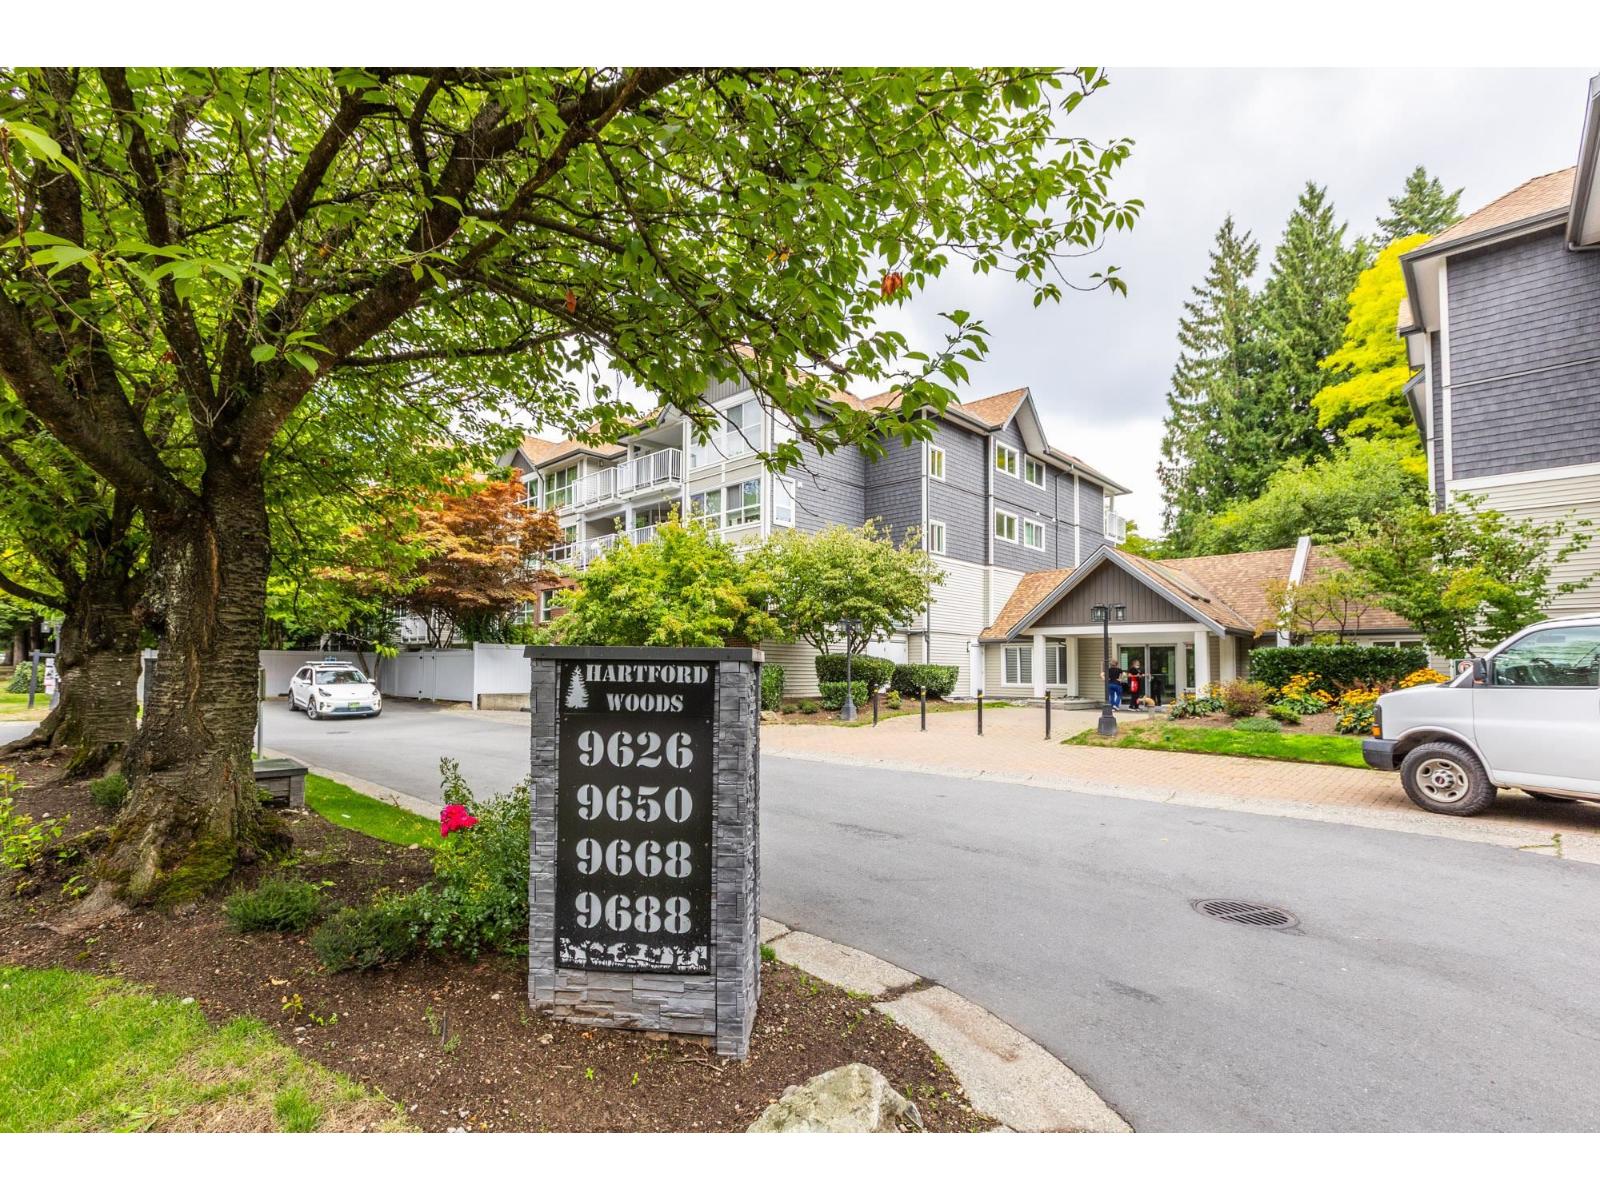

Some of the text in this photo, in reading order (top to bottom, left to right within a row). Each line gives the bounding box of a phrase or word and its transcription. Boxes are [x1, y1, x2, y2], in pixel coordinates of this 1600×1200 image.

[586, 664, 708, 684] HARTFORD
[606, 693, 683, 712] WOODS
[577, 730, 693, 769] 9626
[577, 784, 693, 823] 9650
[575, 837, 692, 878] 9668
[575, 891, 691, 933] 9688
